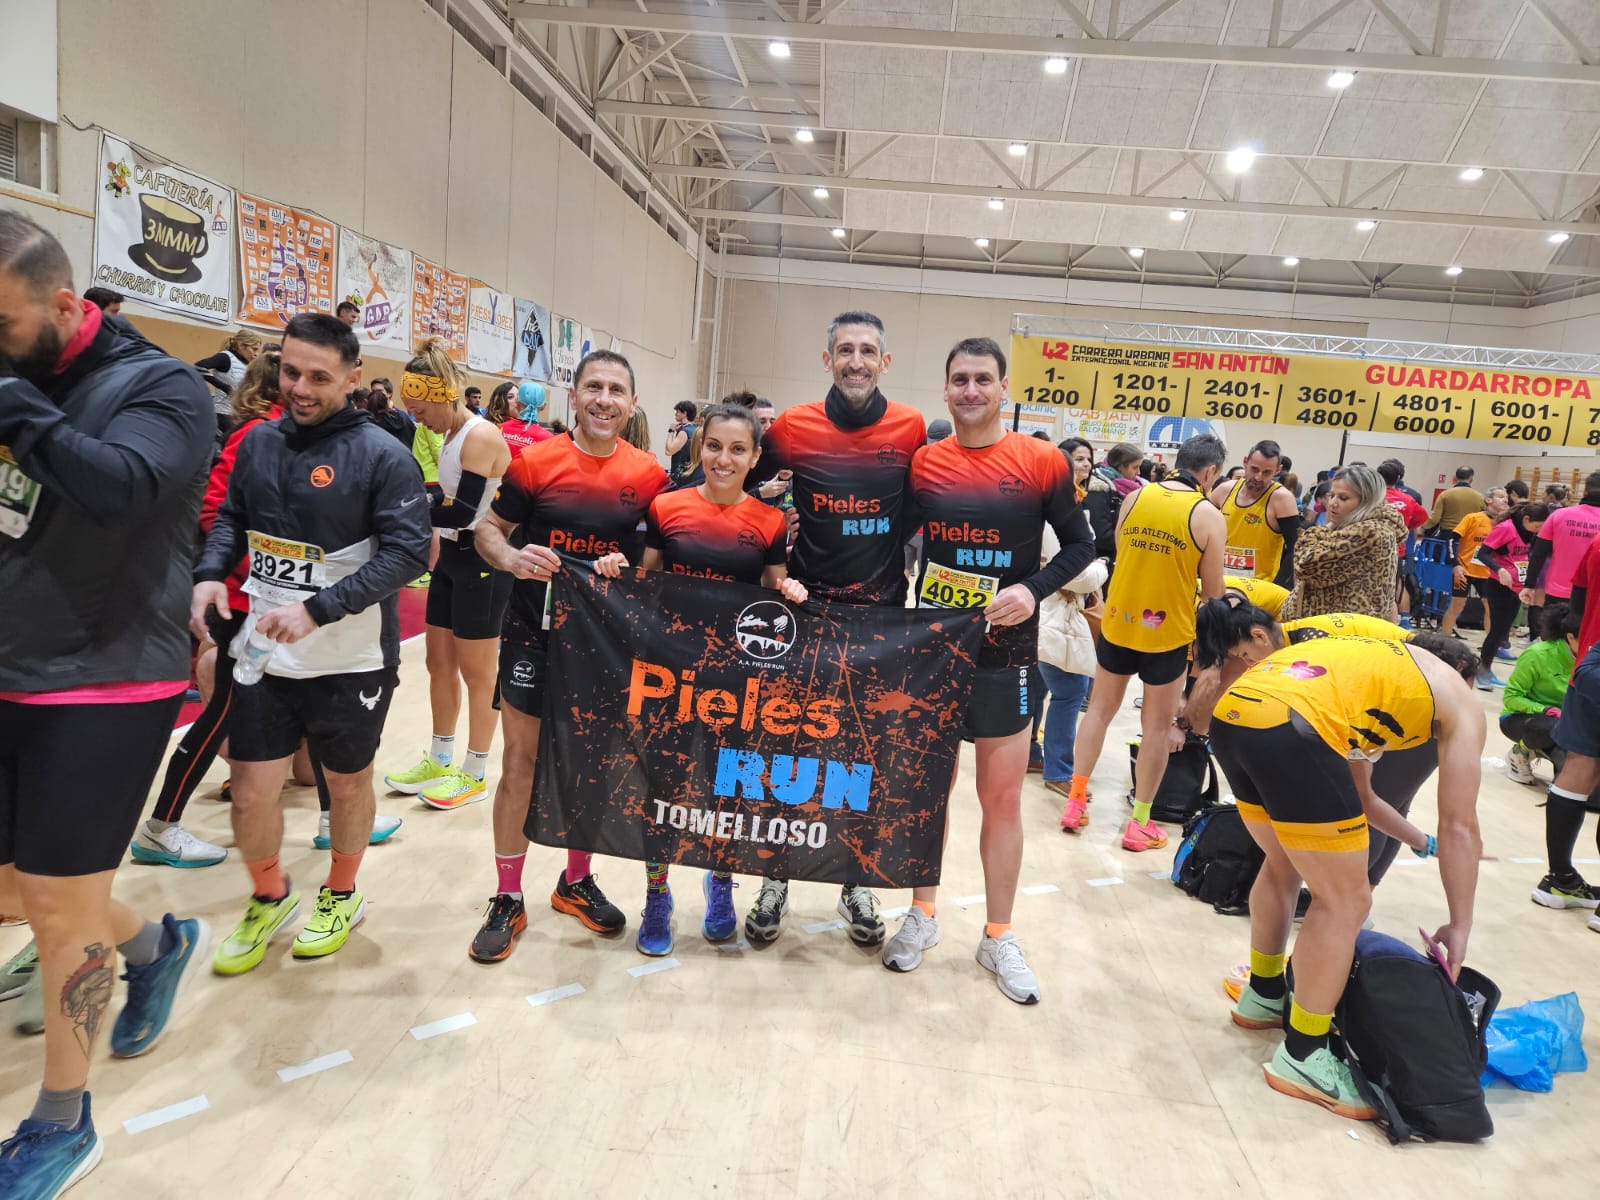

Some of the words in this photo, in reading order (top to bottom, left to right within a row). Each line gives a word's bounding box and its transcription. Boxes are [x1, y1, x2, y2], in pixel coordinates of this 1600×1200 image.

[134, 165, 213, 214] CAFETERÍA
[98, 264, 156, 295] CHURROS
[157, 282, 166, 298] Y
[169, 286, 229, 313] CHOCOLATE
[1042, 341, 1069, 361] 42
[1072, 344, 1122, 357] CARRERA
[1125, 349, 1170, 362] URBANA
[1172, 351, 1214, 370] SAN
[1071, 355, 1131, 366] INTERNACIONAL
[1044, 367, 1065, 383] 1-
[1113, 372, 1177, 392] 1201-
[1365, 364, 1592, 400] GUARDARROPA
[1023, 386, 1080, 406] 1200
[1204, 379, 1270, 398] 2401-
[1297, 386, 1366, 406] 3601-
[1112, 394, 1171, 413] 2400
[1205, 400, 1263, 420] 3600
[1393, 394, 1462, 413] 4801-
[1491, 401, 1560, 420] 6001-
[1296, 408, 1358, 427] 4800
[1393, 415, 1455, 435] 6000
[1492, 422, 1552, 441] 7200
[813, 493, 880, 514] Pieles
[842, 517, 890, 536] RUN
[928, 521, 1000, 544] Pieles
[549, 529, 619, 555] Pieles
[1123, 526, 1140, 536] CLUB
[1142, 527, 1187, 551] ATLETISMO
[1130, 538, 1146, 549] SUR
[1149, 542, 1171, 555] ESTE
[254, 550, 313, 584] 8921
[957, 548, 1012, 568] RUN
[927, 581, 987, 608] 4032
[627, 658, 840, 738] Pieles
[714, 746, 873, 811] RUN
[653, 798, 828, 848] TOMELLOSO
